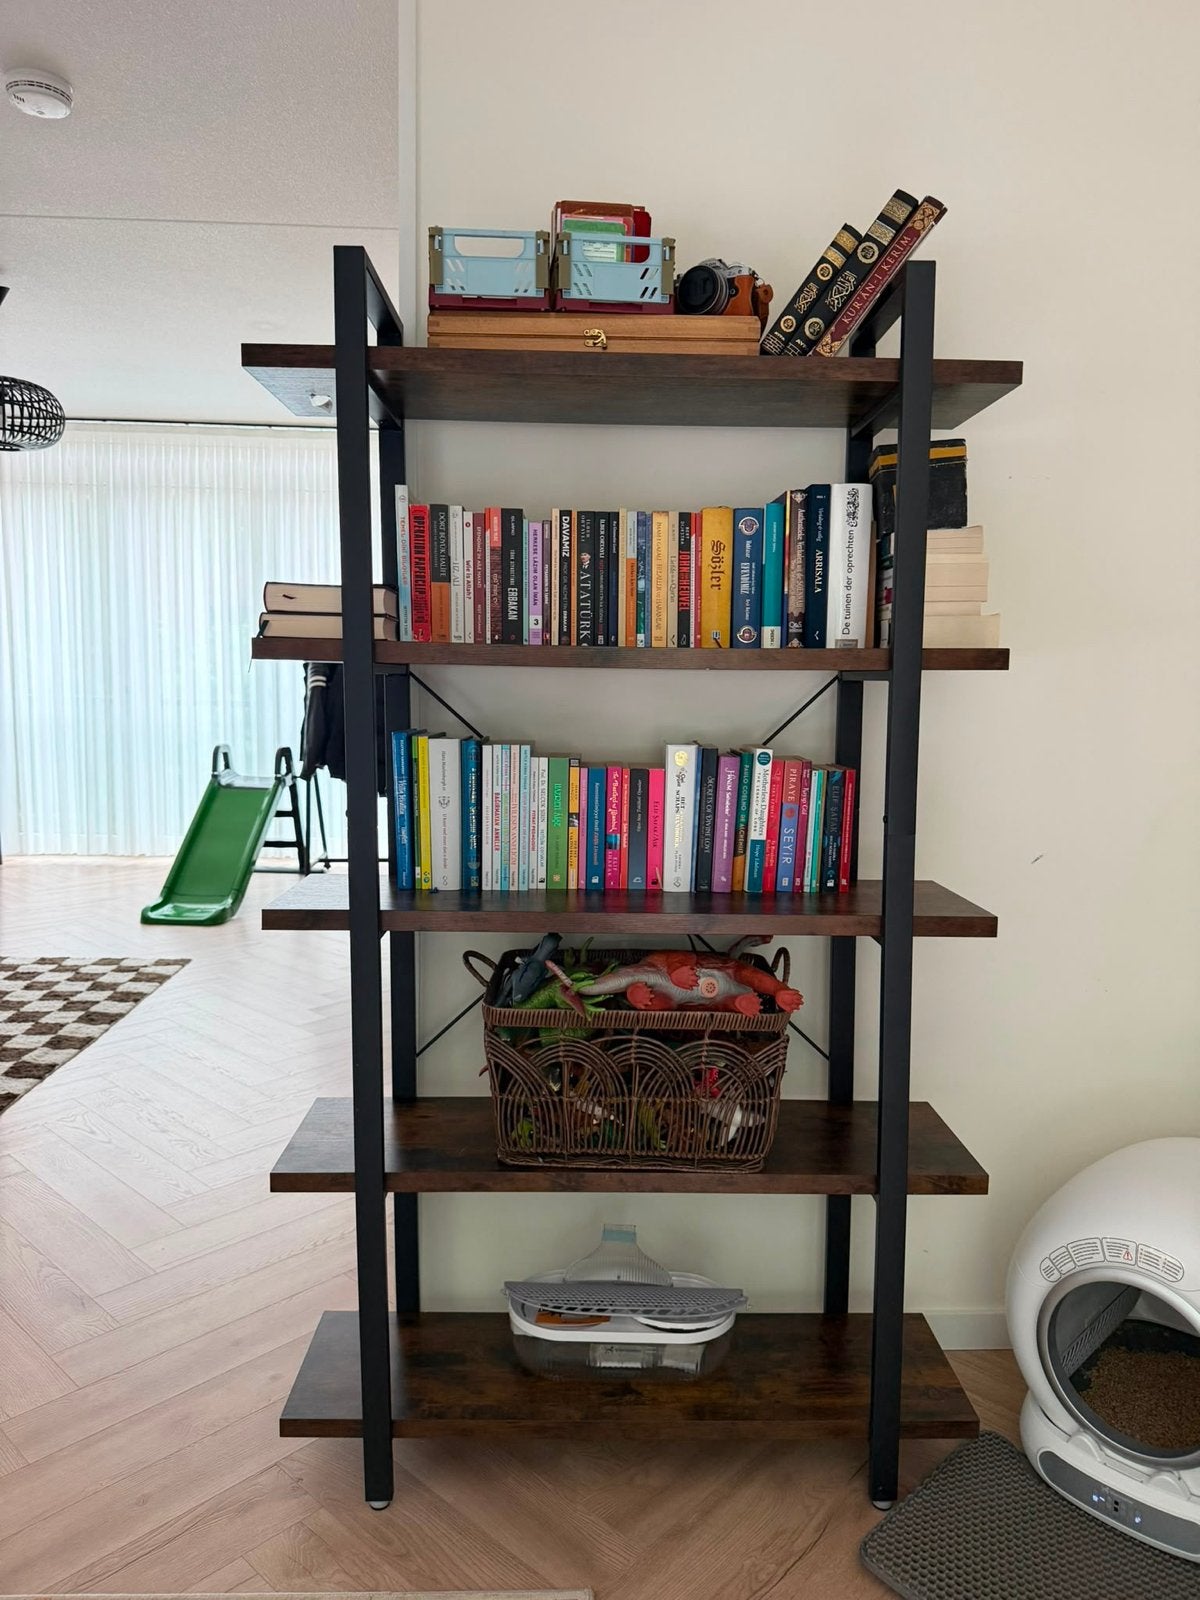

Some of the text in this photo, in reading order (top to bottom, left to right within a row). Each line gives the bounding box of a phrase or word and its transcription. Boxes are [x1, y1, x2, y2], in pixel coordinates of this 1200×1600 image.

[562, 516, 570, 558] DAVAMIZ
[414, 516, 426, 594] OPERATION PAPERCLIP
[679, 550, 691, 573] JOHN
[707, 540, 726, 591] Sözler
[814, 549, 824, 594] ARRISALA
[679, 579, 690, 612] HEUVEL
[842, 530, 856, 636] De tuinen der oprechten
[508, 588, 518, 620] ERBAKAN
[580, 571, 593, 640] ATATÜRK
[534, 618, 540, 626] 3
[609, 780, 619, 803] Bastard
[706, 776, 715, 804] SECRETS
[762, 768, 770, 804] Motherless
[758, 804, 768, 836] Daughters
